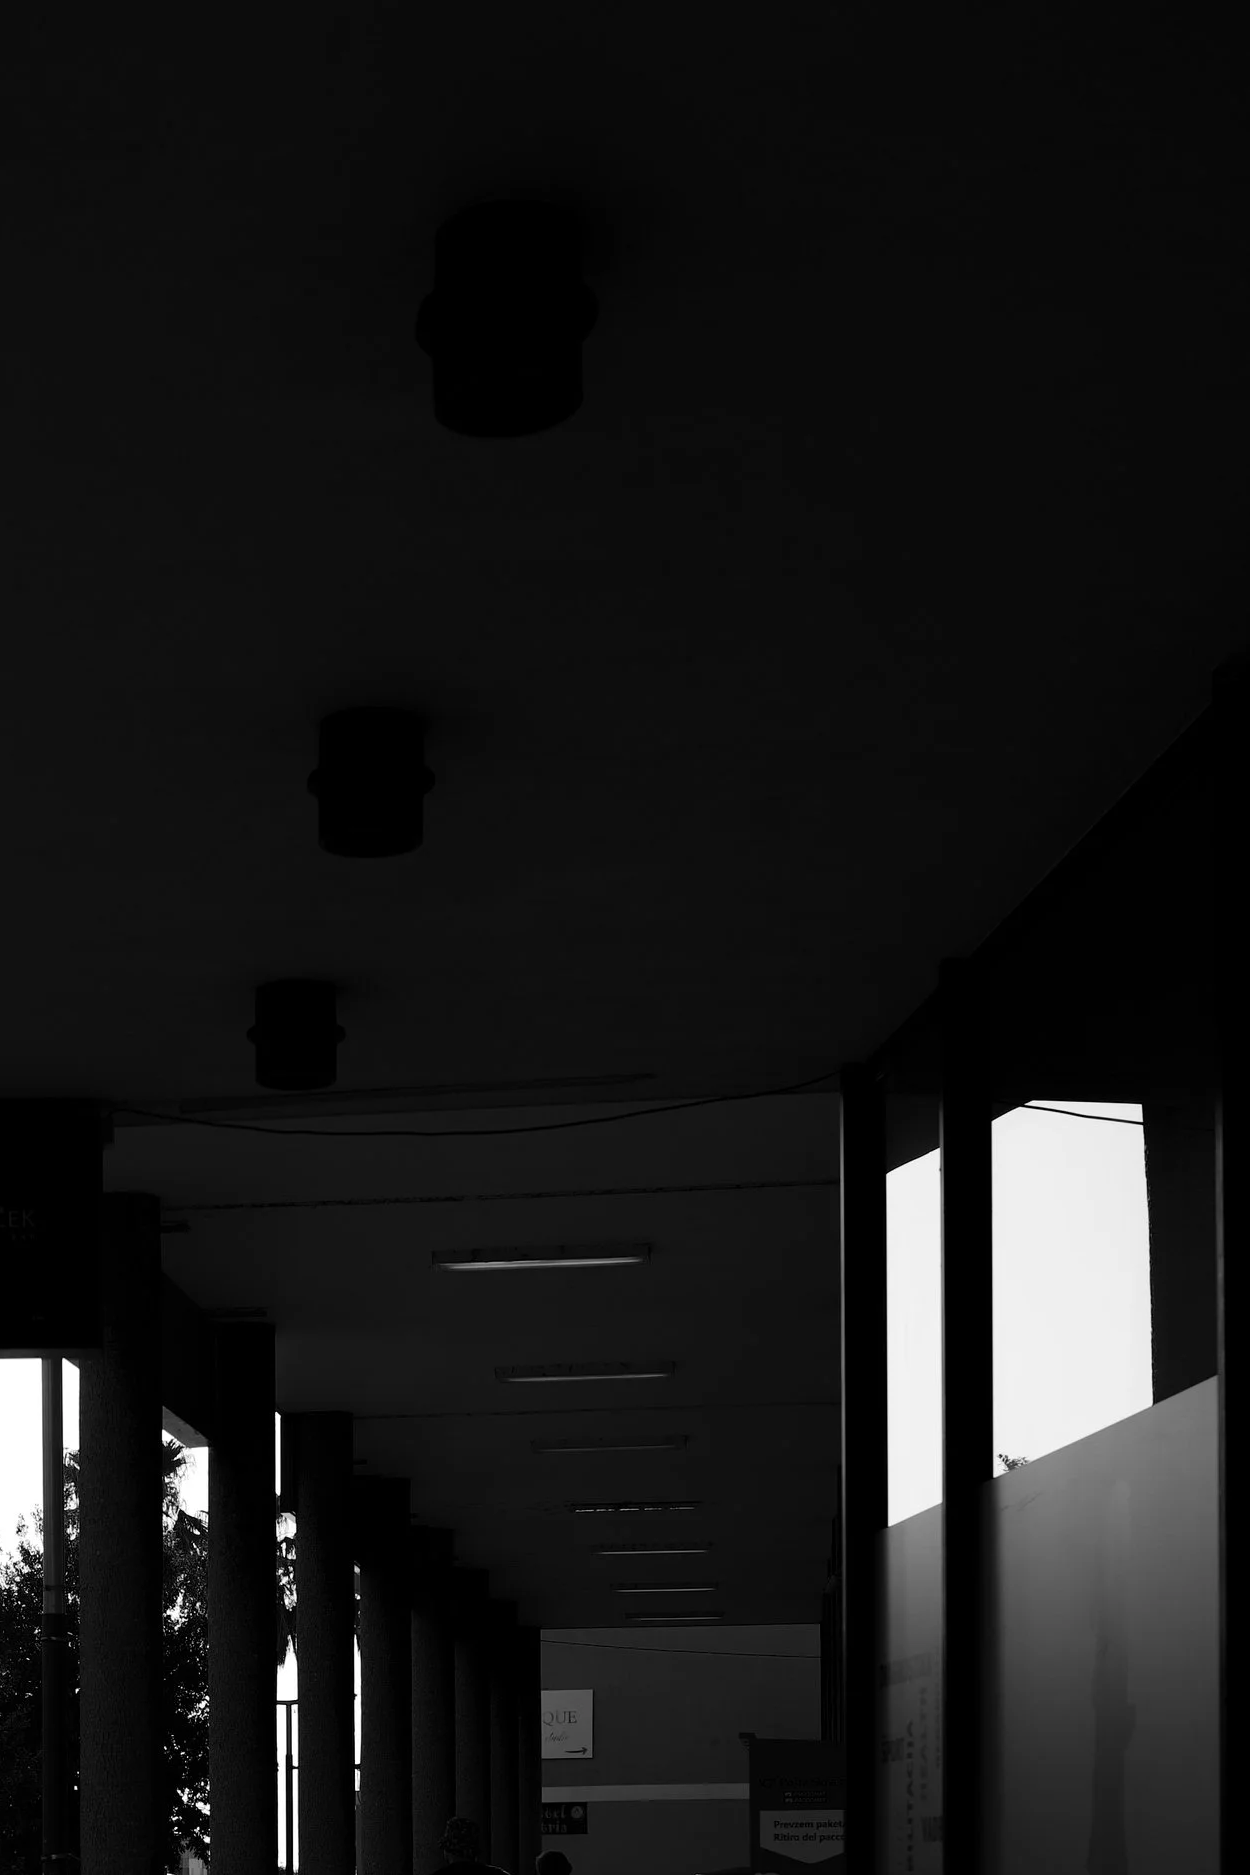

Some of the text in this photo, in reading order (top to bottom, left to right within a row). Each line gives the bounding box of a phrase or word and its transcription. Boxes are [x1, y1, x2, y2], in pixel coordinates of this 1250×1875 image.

[774, 1820, 814, 1828] Prevzem
[774, 1832, 799, 1841] Ritiro
[803, 1832, 817, 1841] del
